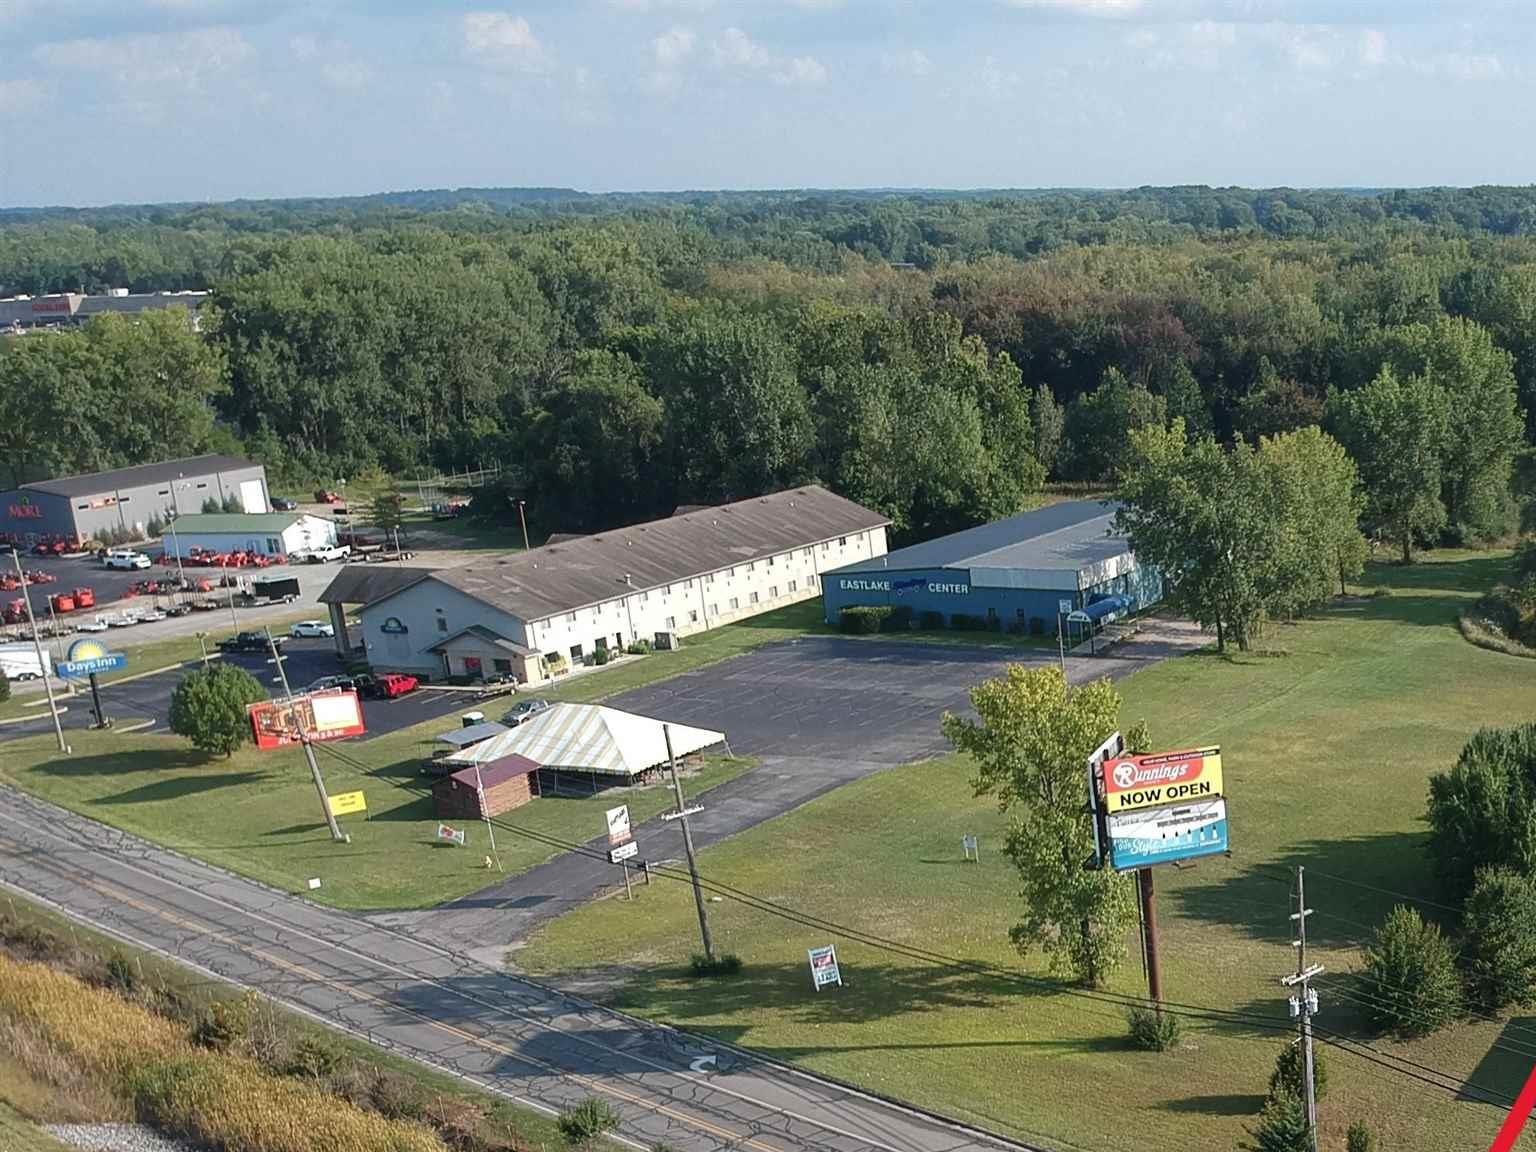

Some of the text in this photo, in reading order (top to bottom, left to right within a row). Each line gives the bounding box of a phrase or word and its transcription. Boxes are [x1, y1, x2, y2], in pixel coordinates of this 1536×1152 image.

[840, 579, 969, 594] EASTLAKE CENTER
[66, 661, 96, 673] Days
[96, 656, 117, 668] Inn
[1113, 762, 1189, 788] Runnings
[1120, 781, 1210, 807] NOW OPEN
